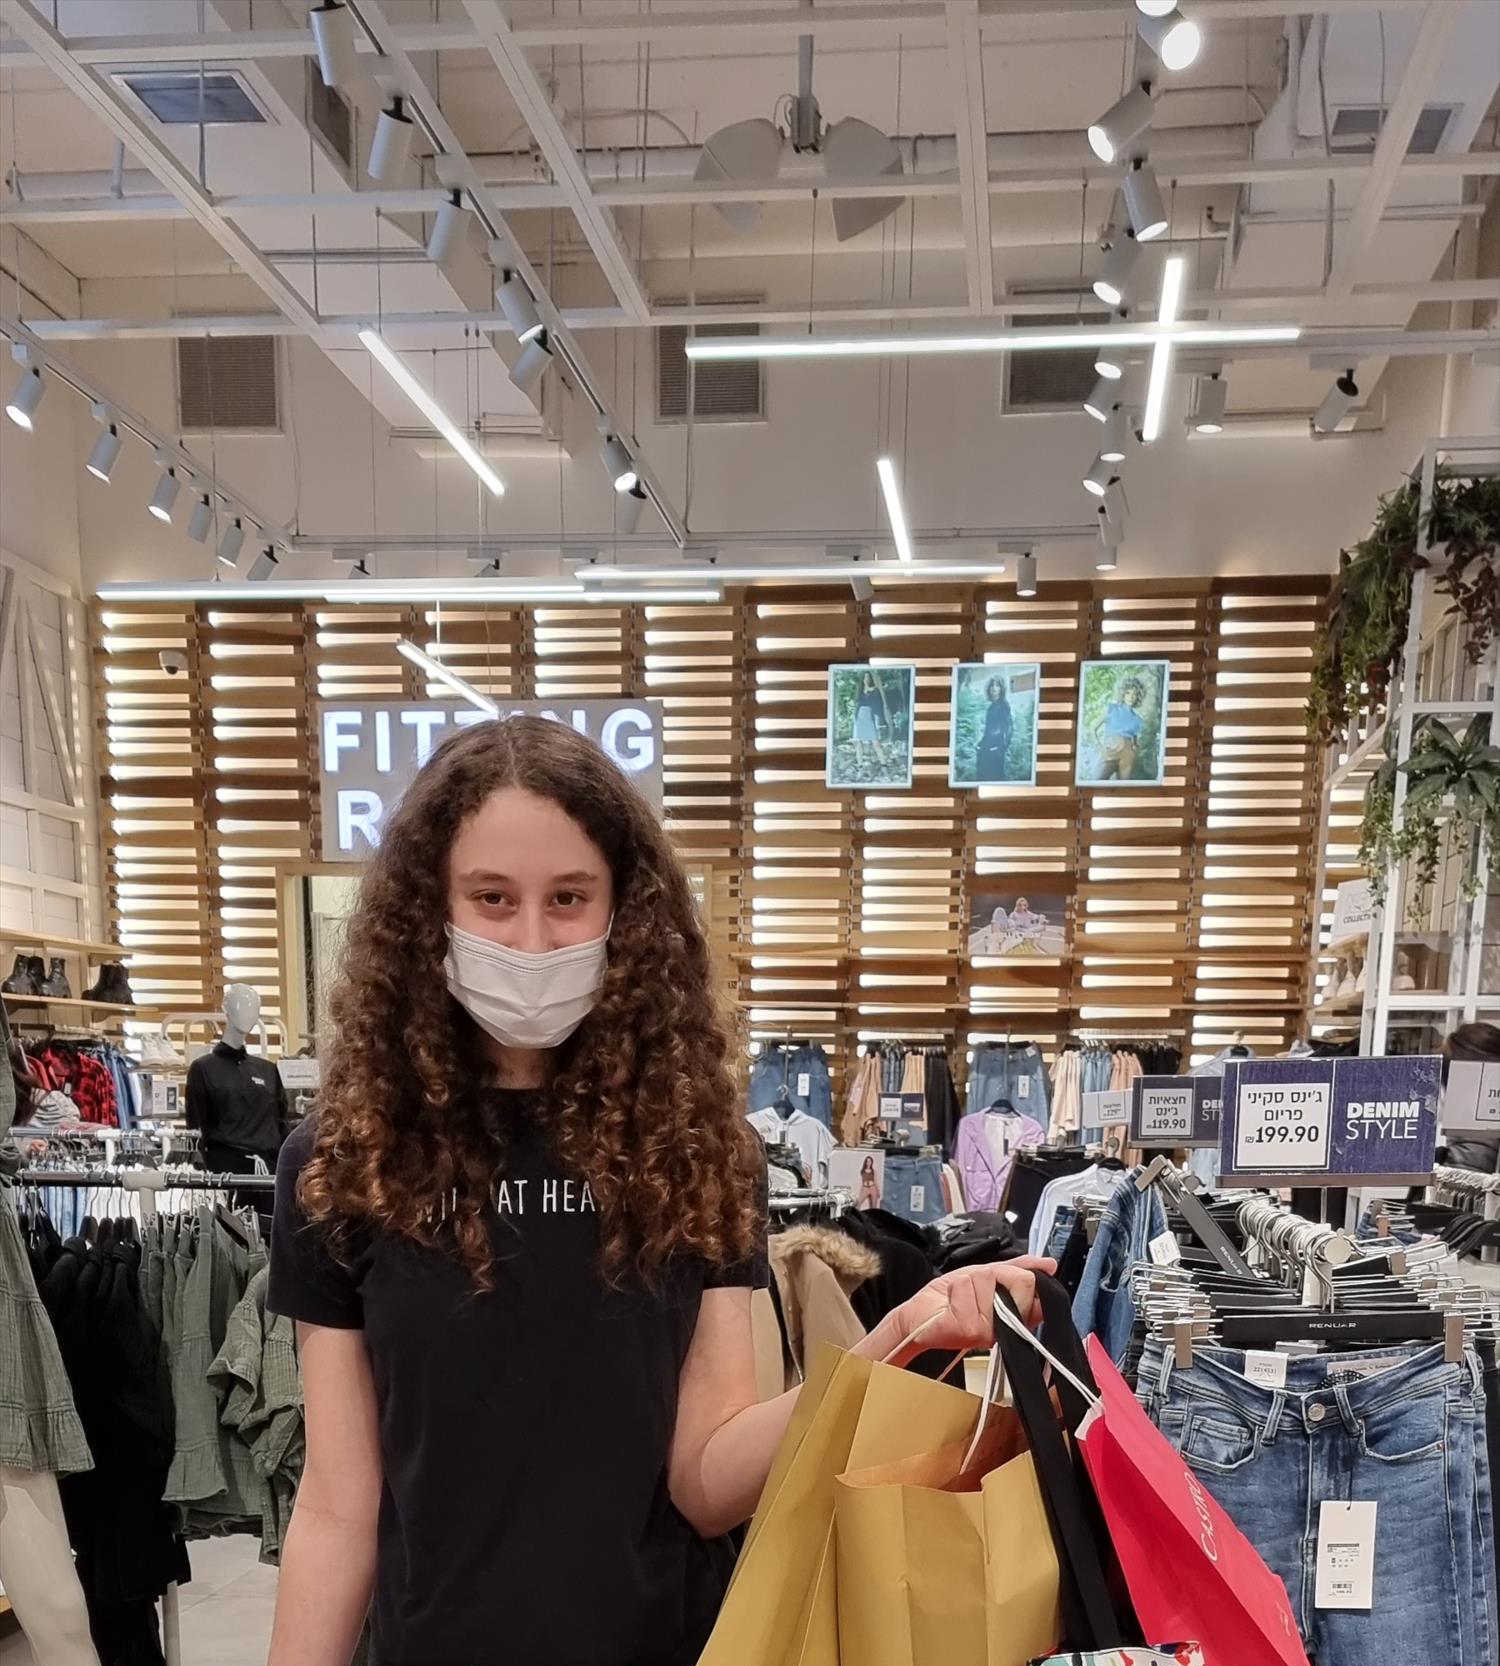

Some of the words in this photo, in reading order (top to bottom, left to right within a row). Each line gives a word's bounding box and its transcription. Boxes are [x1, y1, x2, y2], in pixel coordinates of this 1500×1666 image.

[323, 708, 655, 772] FITG
[1247, 1091, 1284, 1106] סקיני
[1264, 1109, 1303, 1121] פריום
[1346, 1101, 1420, 1118] DENIM
[1345, 1119, 1418, 1140] STYLE
[498, 1179, 528, 1215] AT
[543, 1179, 627, 1213] HEA
